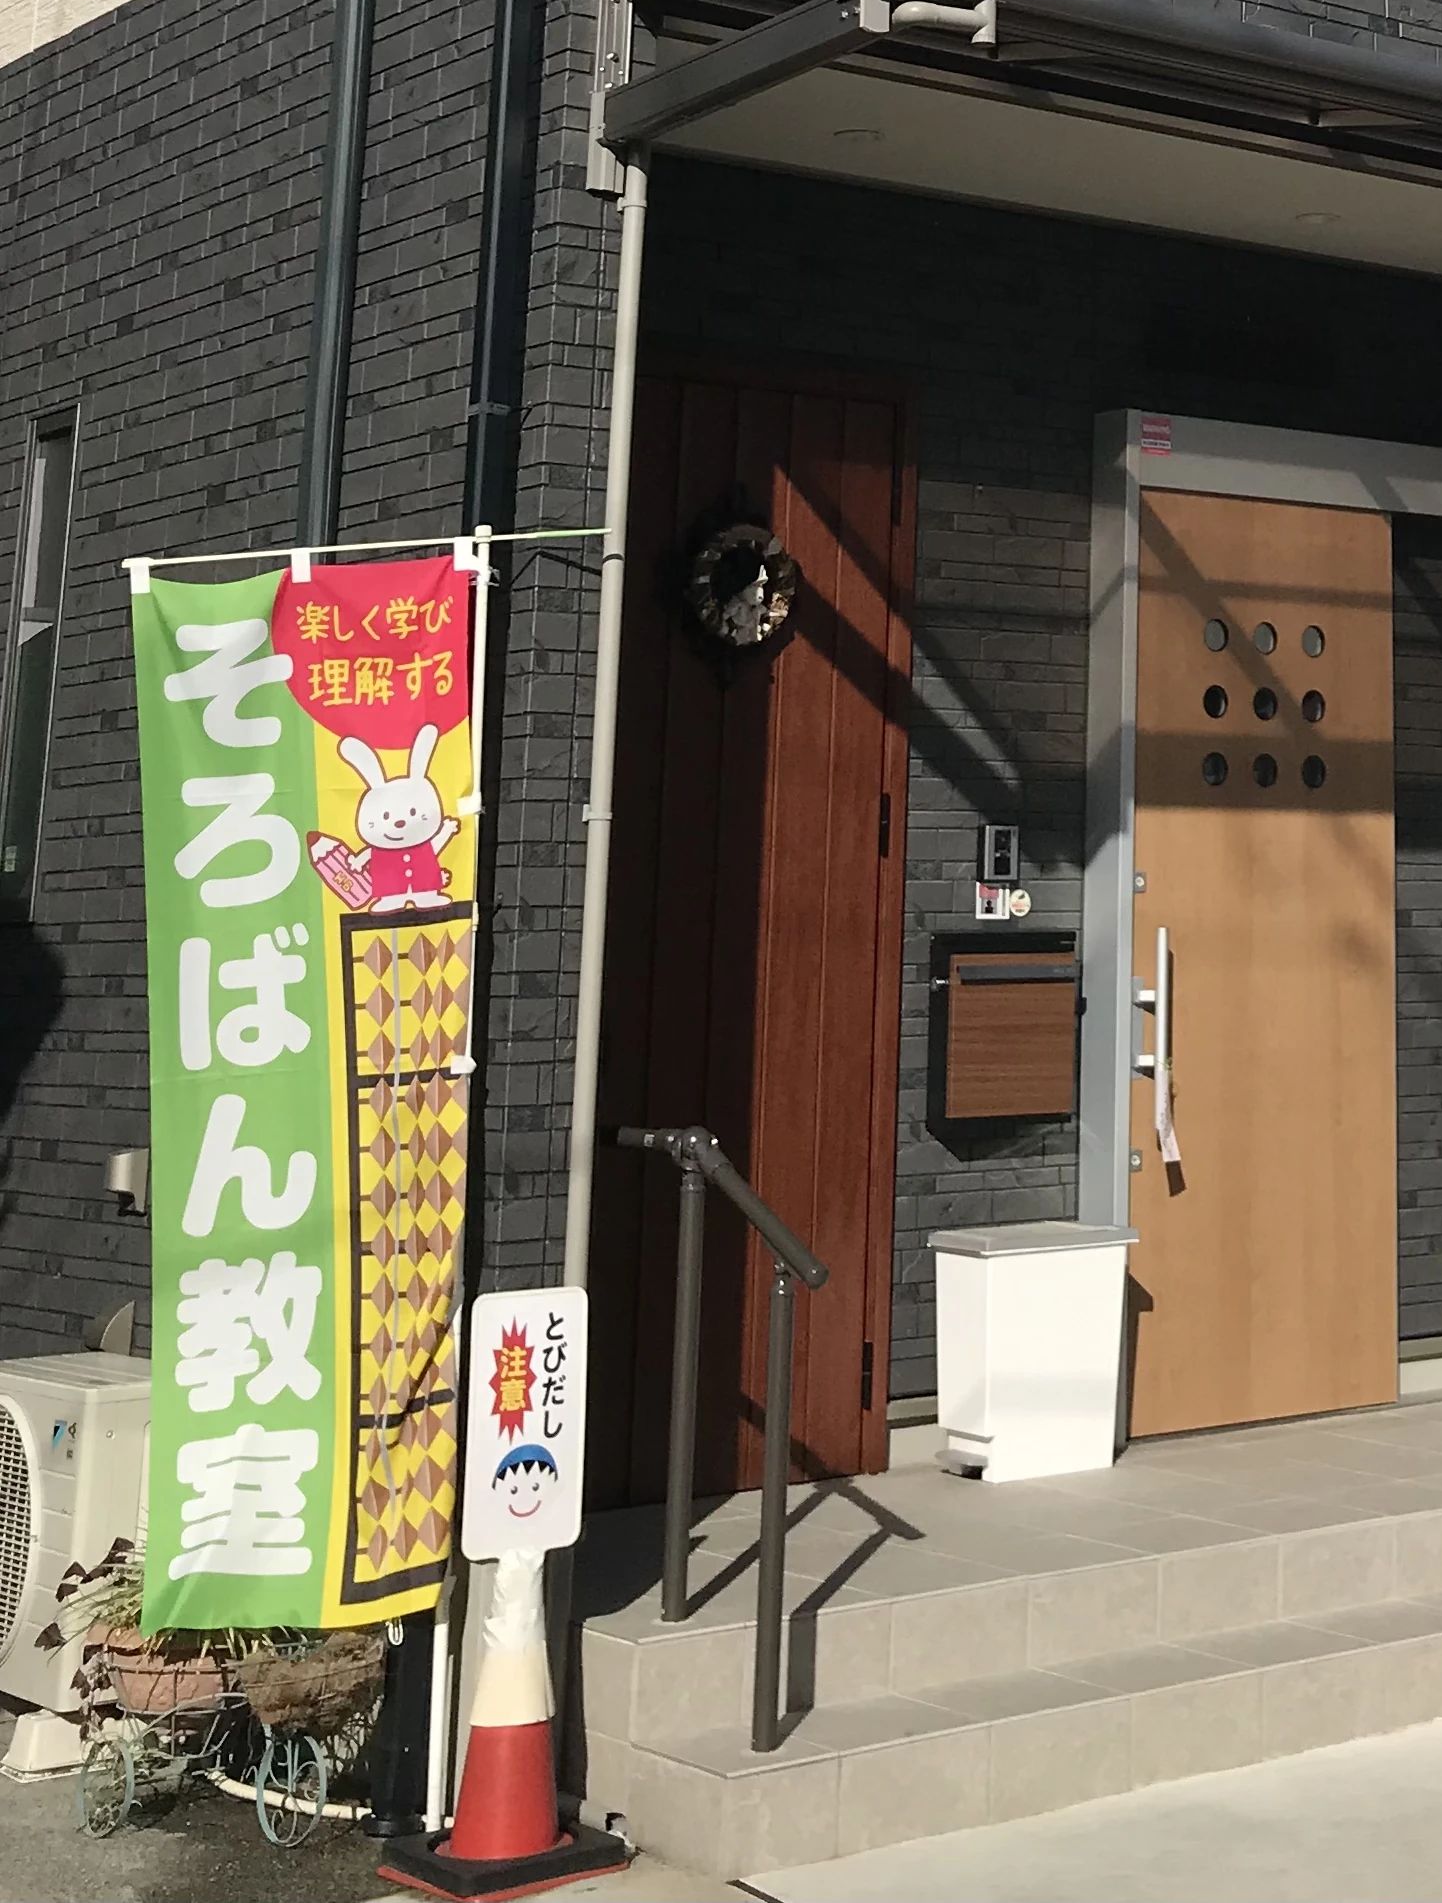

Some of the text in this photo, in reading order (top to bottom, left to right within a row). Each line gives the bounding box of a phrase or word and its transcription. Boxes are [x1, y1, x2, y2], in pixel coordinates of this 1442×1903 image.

[296, 596, 454, 645] 楽しく学び
[307, 650, 454, 707] 理解する
[163, 618, 324, 1581] そろばん教室
[499, 1345, 528, 1411] 注意
[541, 1312, 568, 1439] とびだし
